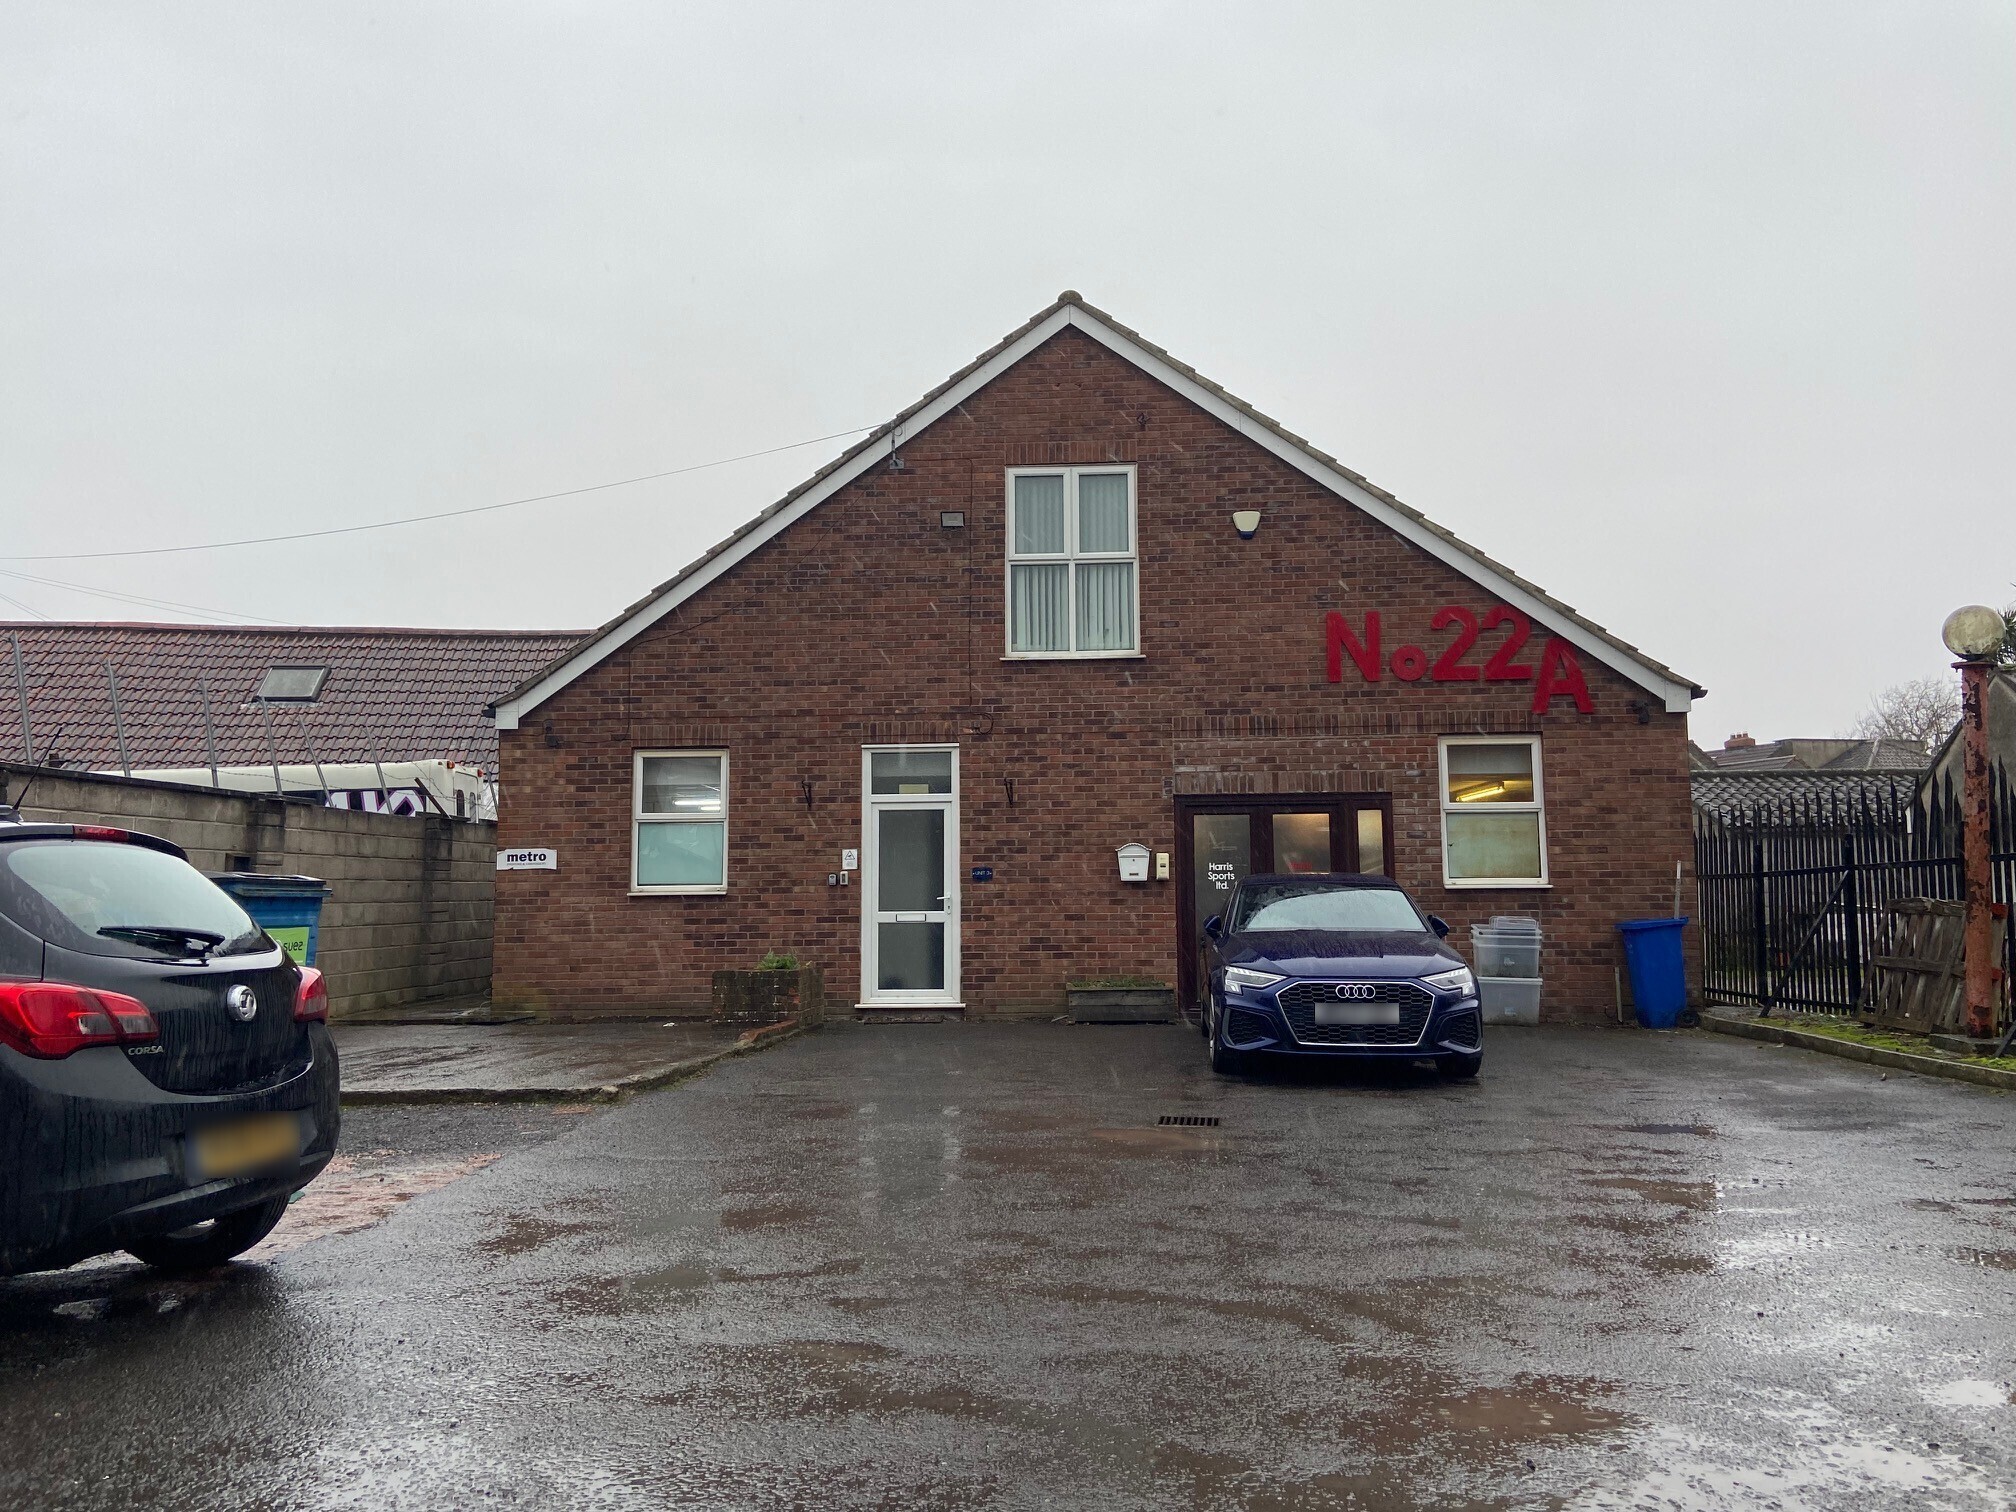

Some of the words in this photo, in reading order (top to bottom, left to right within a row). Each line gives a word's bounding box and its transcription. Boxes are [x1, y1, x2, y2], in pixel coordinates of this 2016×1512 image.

[507, 851, 547, 862] metro
[1208, 862, 1233, 871] Harris
[1207, 871, 1235, 882] Sports
[1215, 880, 1230, 890] ltd.
[283, 941, 304, 952] suez
[128, 1045, 164, 1056] CORSA
